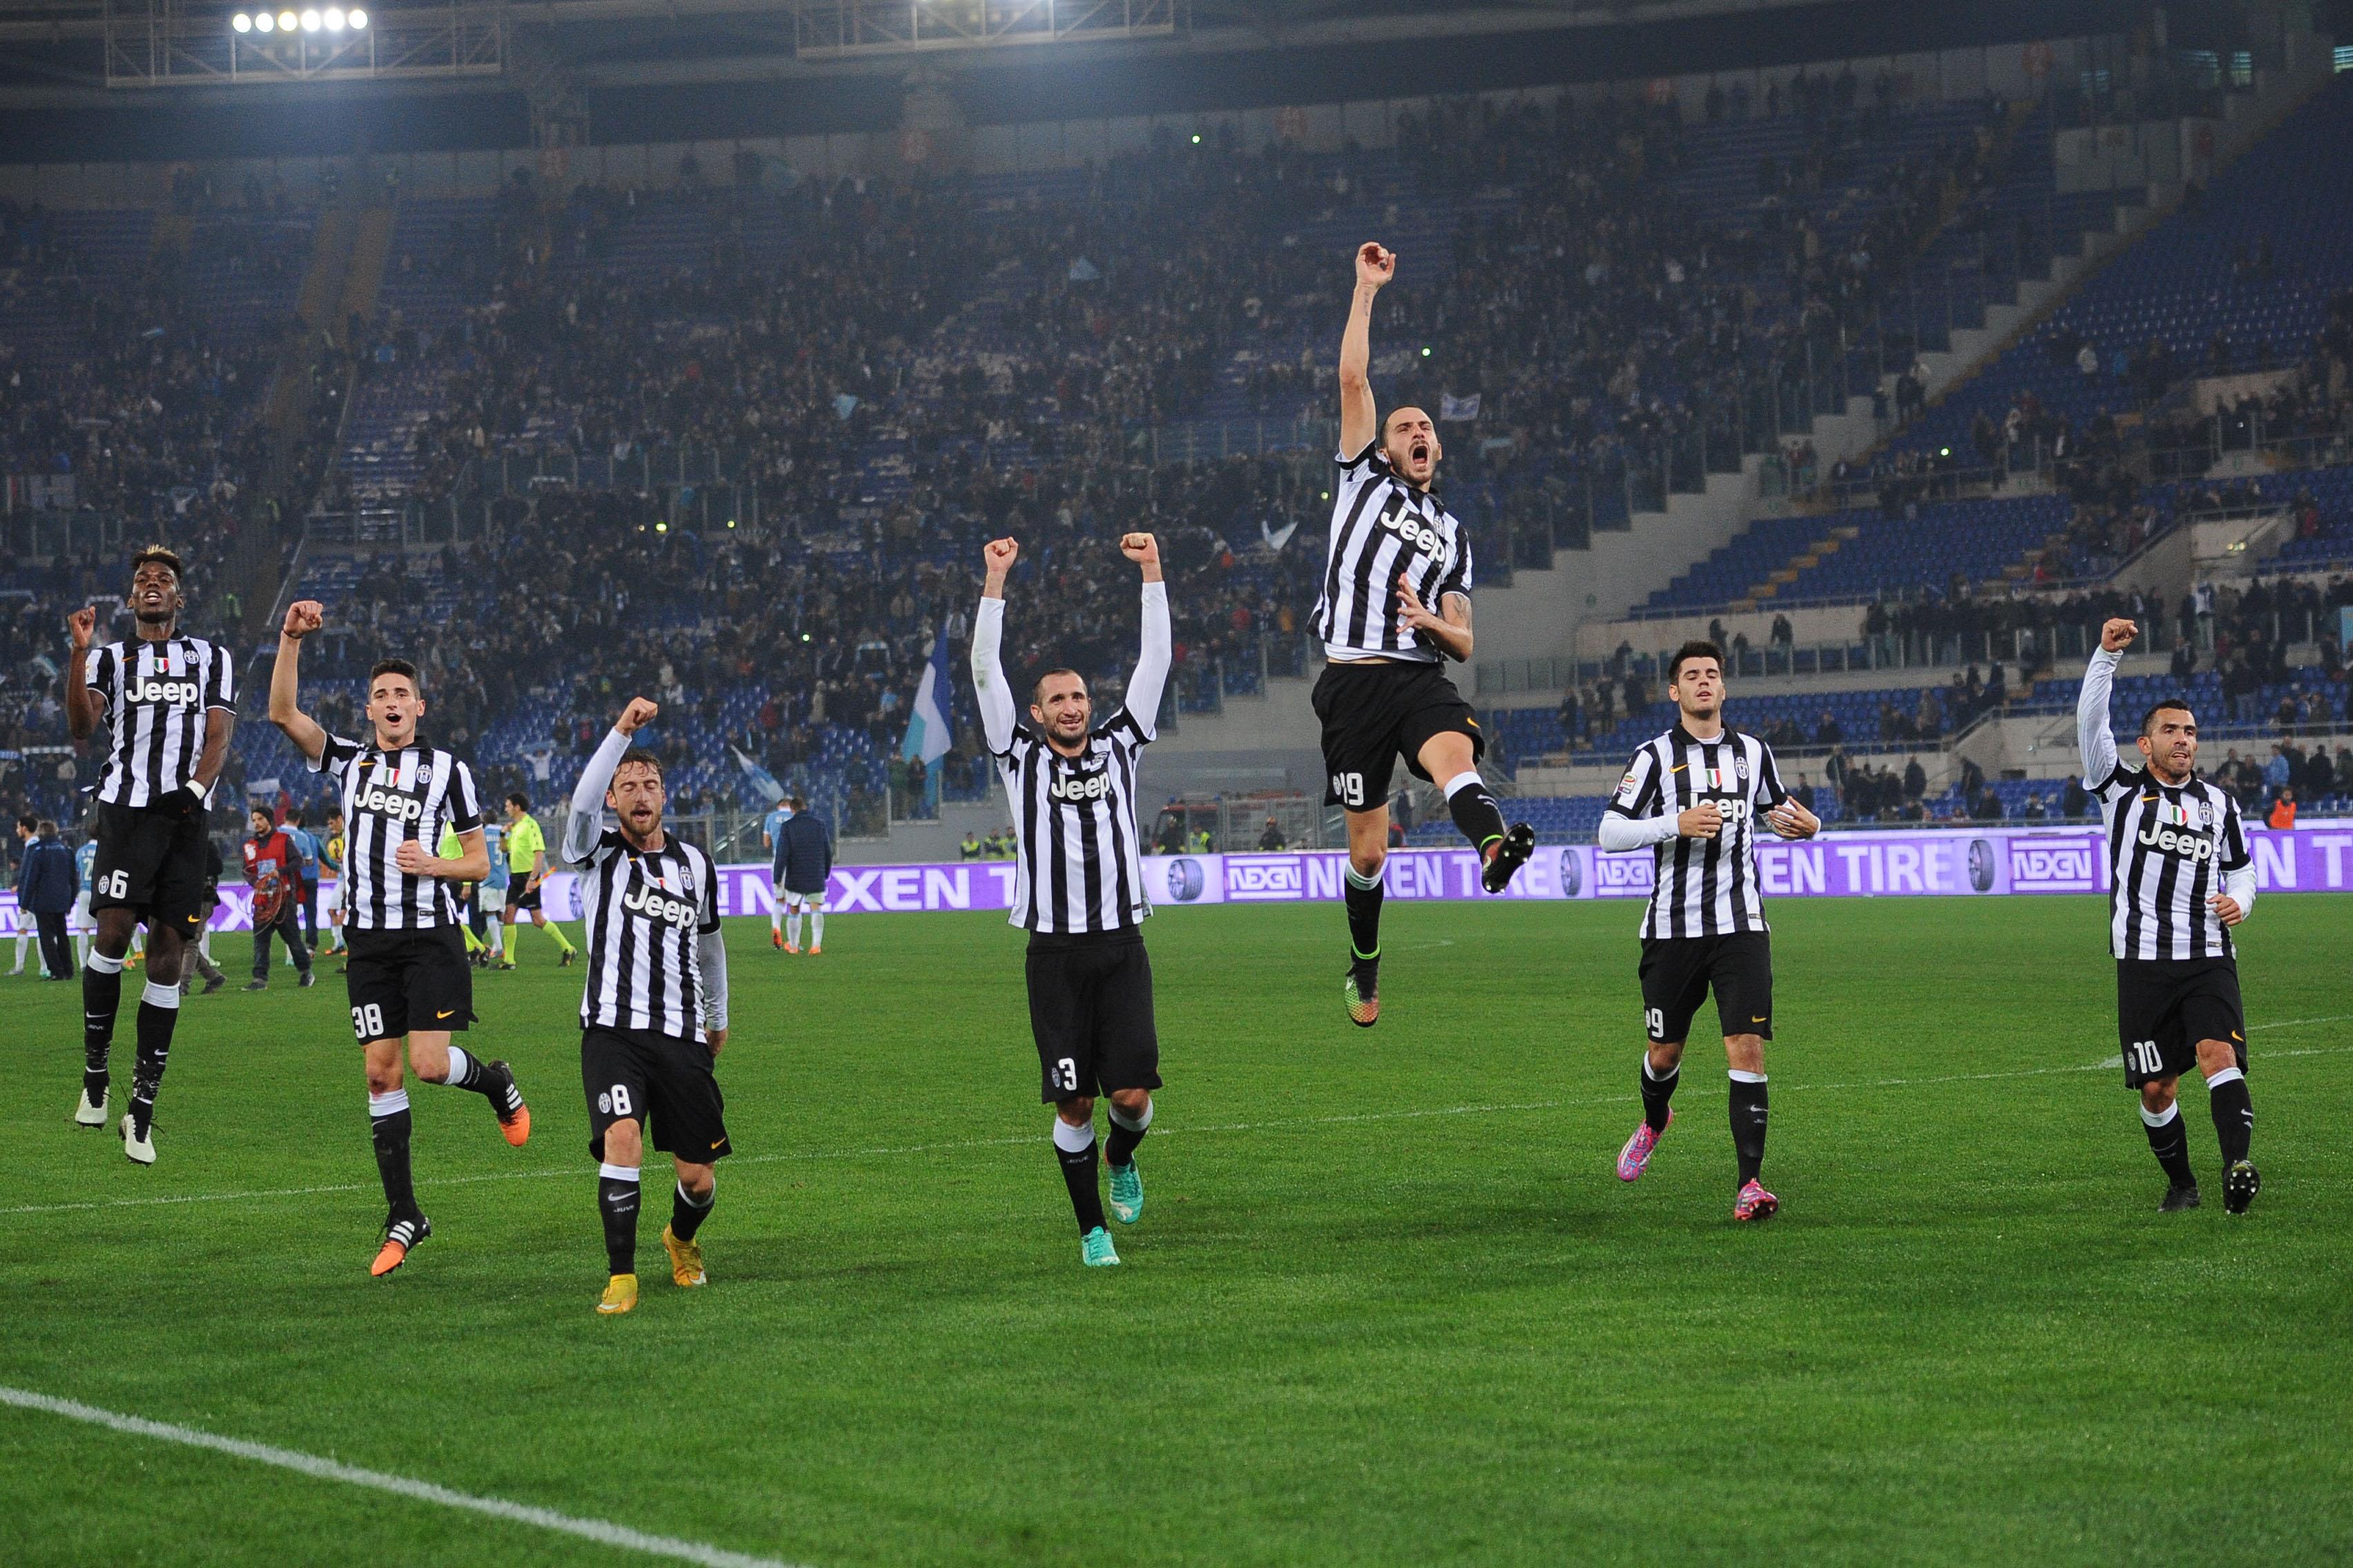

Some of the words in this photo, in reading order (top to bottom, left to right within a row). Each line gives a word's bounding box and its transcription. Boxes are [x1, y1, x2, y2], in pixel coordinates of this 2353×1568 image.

[1381, 506, 1446, 562] Jeep
[125, 676, 198, 707] Jeep
[354, 782, 421, 822] Jeep
[1051, 772, 1110, 800] Jeep
[1340, 772, 1364, 806] 19
[2138, 821, 2213, 862] Jeep
[110, 869, 129, 900] 6
[1306, 854, 1443, 898] NEN
[1837, 844, 1955, 893] TIRE
[624, 883, 695, 931] Jeep
[740, 867, 970, 916] NXEN
[352, 1003, 384, 1038] 38
[1651, 1007, 1664, 1038] 9
[2133, 1040, 2163, 1074] 10
[1058, 1058, 1077, 1091] 3
[611, 1084, 631, 1116] 8
